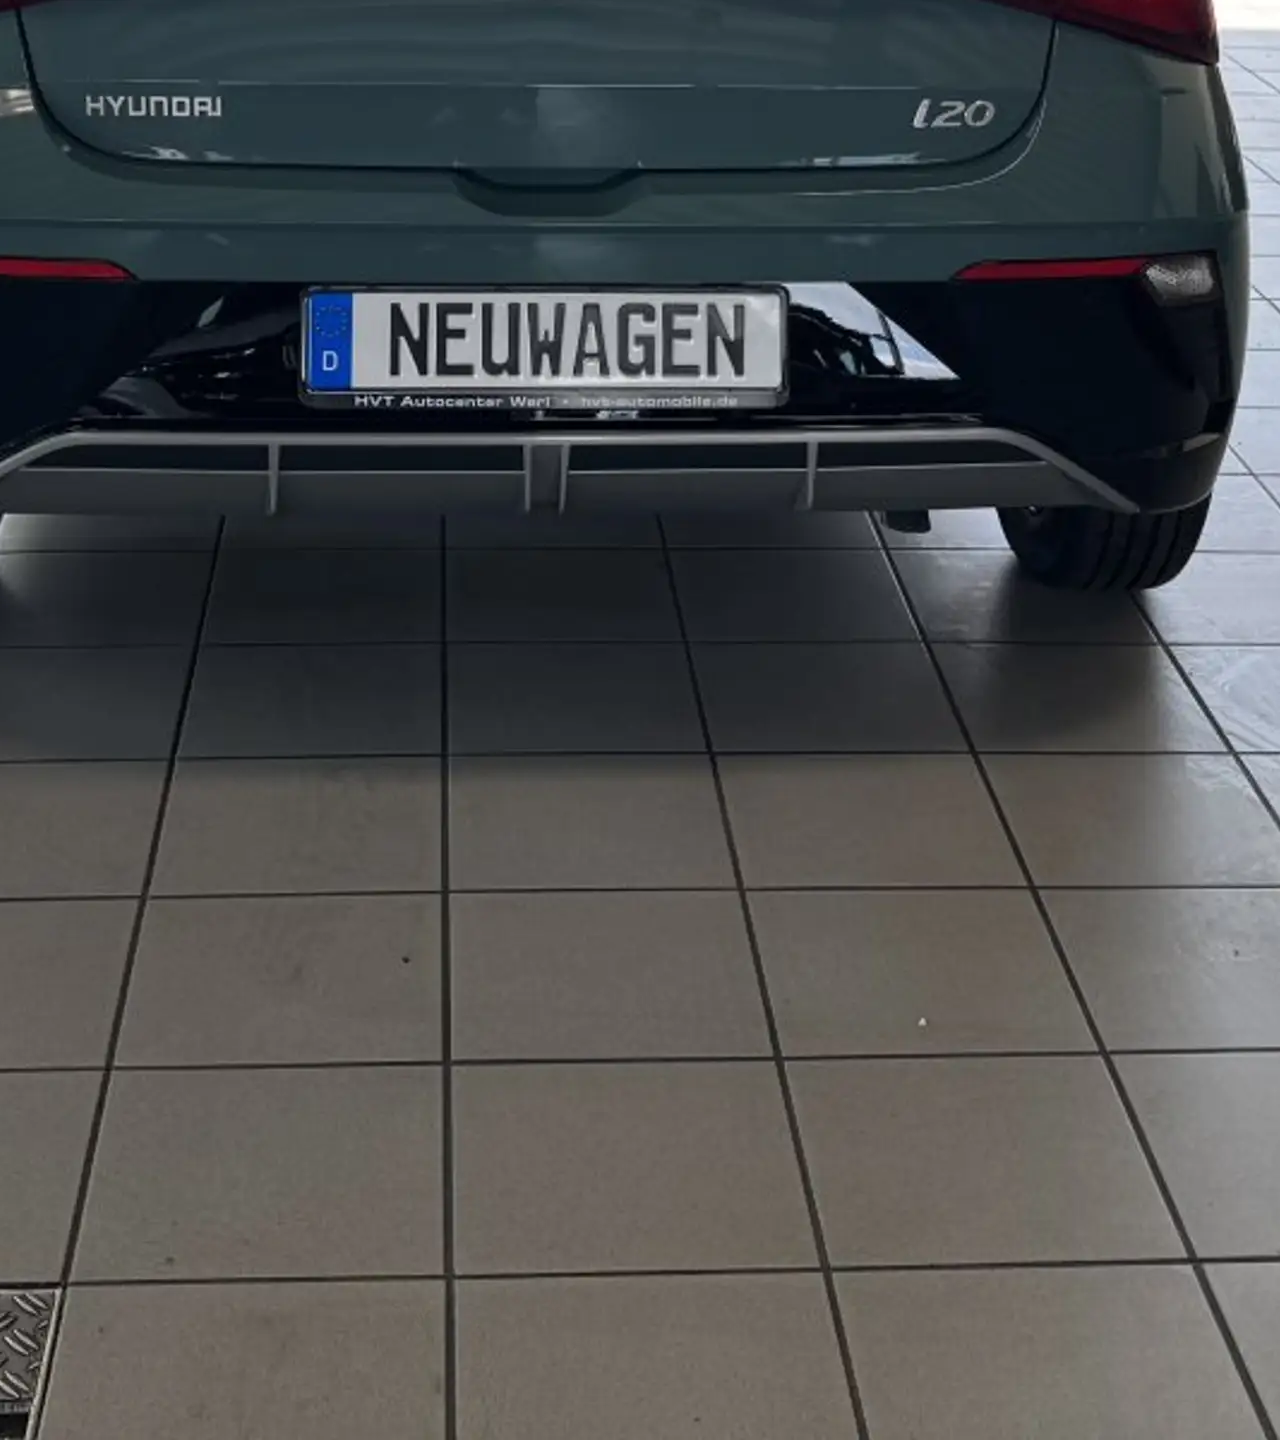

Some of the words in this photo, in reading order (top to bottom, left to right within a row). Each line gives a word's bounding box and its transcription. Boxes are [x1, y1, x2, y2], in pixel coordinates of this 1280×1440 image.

[85, 95, 222, 117] HYUNDAI
[389, 302, 745, 377] NEUWAGEN
[323, 351, 338, 371] D
[354, 395, 395, 407] HVT
[400, 395, 503, 408] Autocenter
[509, 395, 551, 408] Werl
